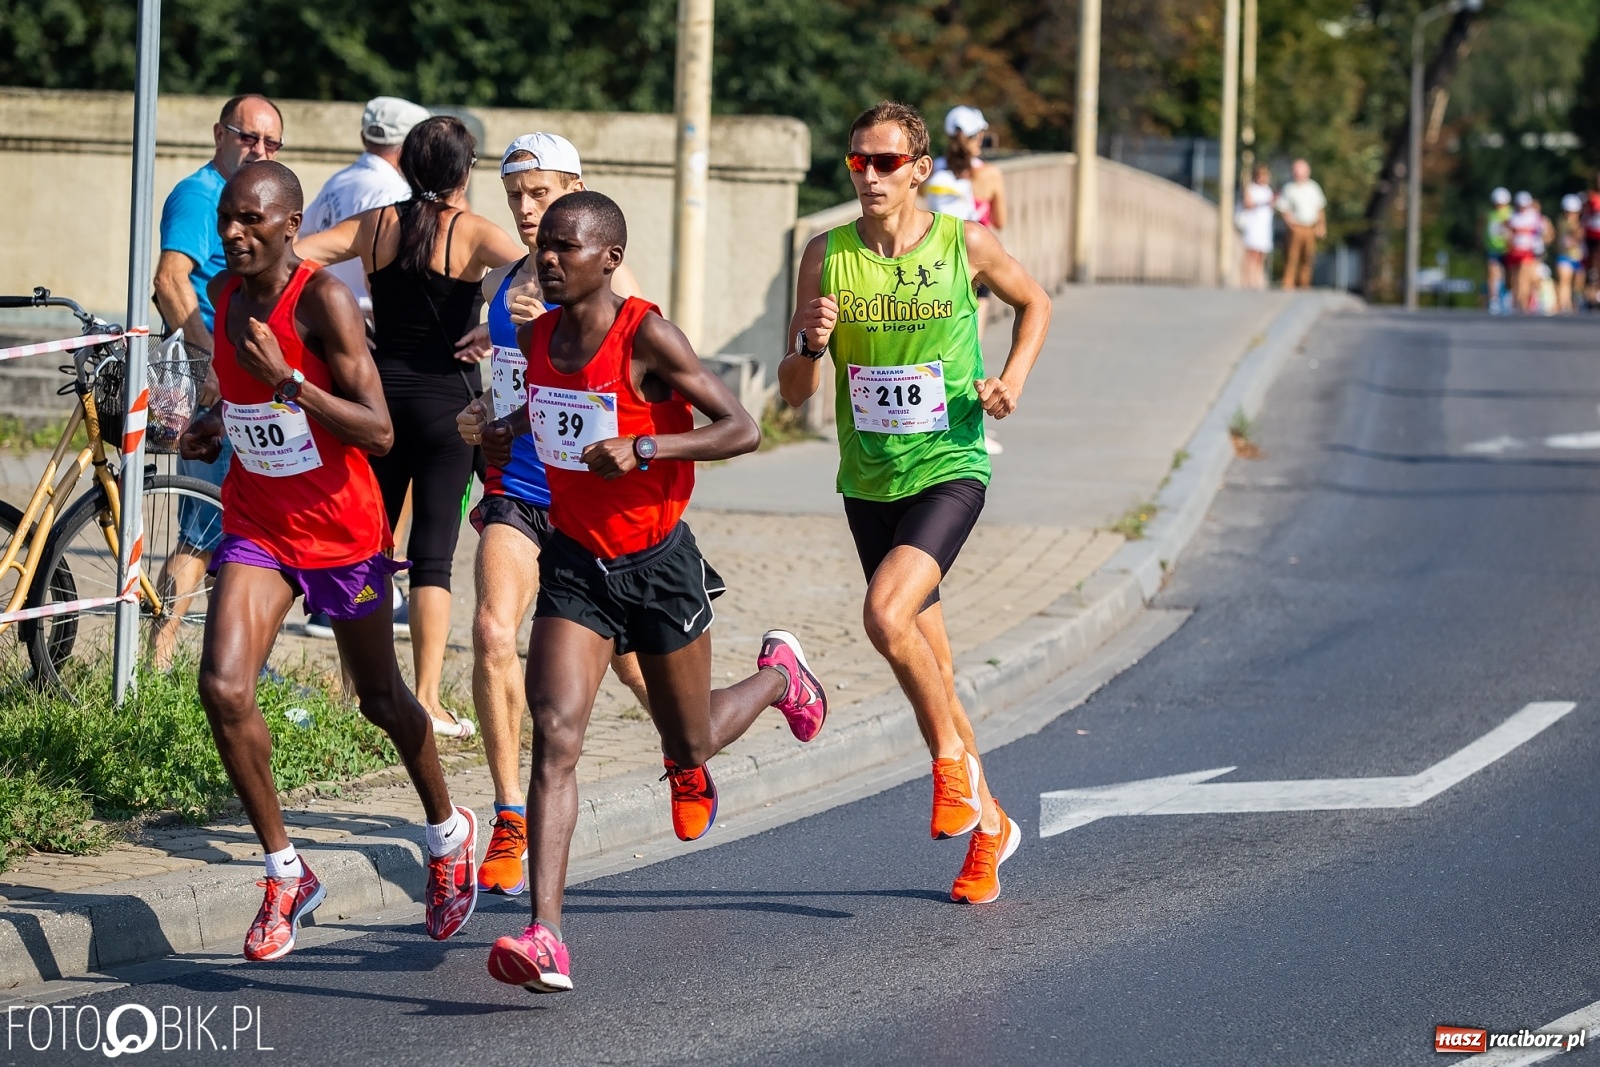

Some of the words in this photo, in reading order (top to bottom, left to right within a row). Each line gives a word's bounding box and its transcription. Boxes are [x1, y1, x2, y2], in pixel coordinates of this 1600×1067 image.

[838, 289, 953, 323] Radlinioki
[866, 325, 878, 333] w
[883, 322, 926, 334] biegu
[553, 392, 578, 400] RAFAKO
[875, 383, 922, 407] 218
[244, 423, 285, 448] 130
[557, 410, 584, 439] 39
[353, 592, 378, 604] adidas
